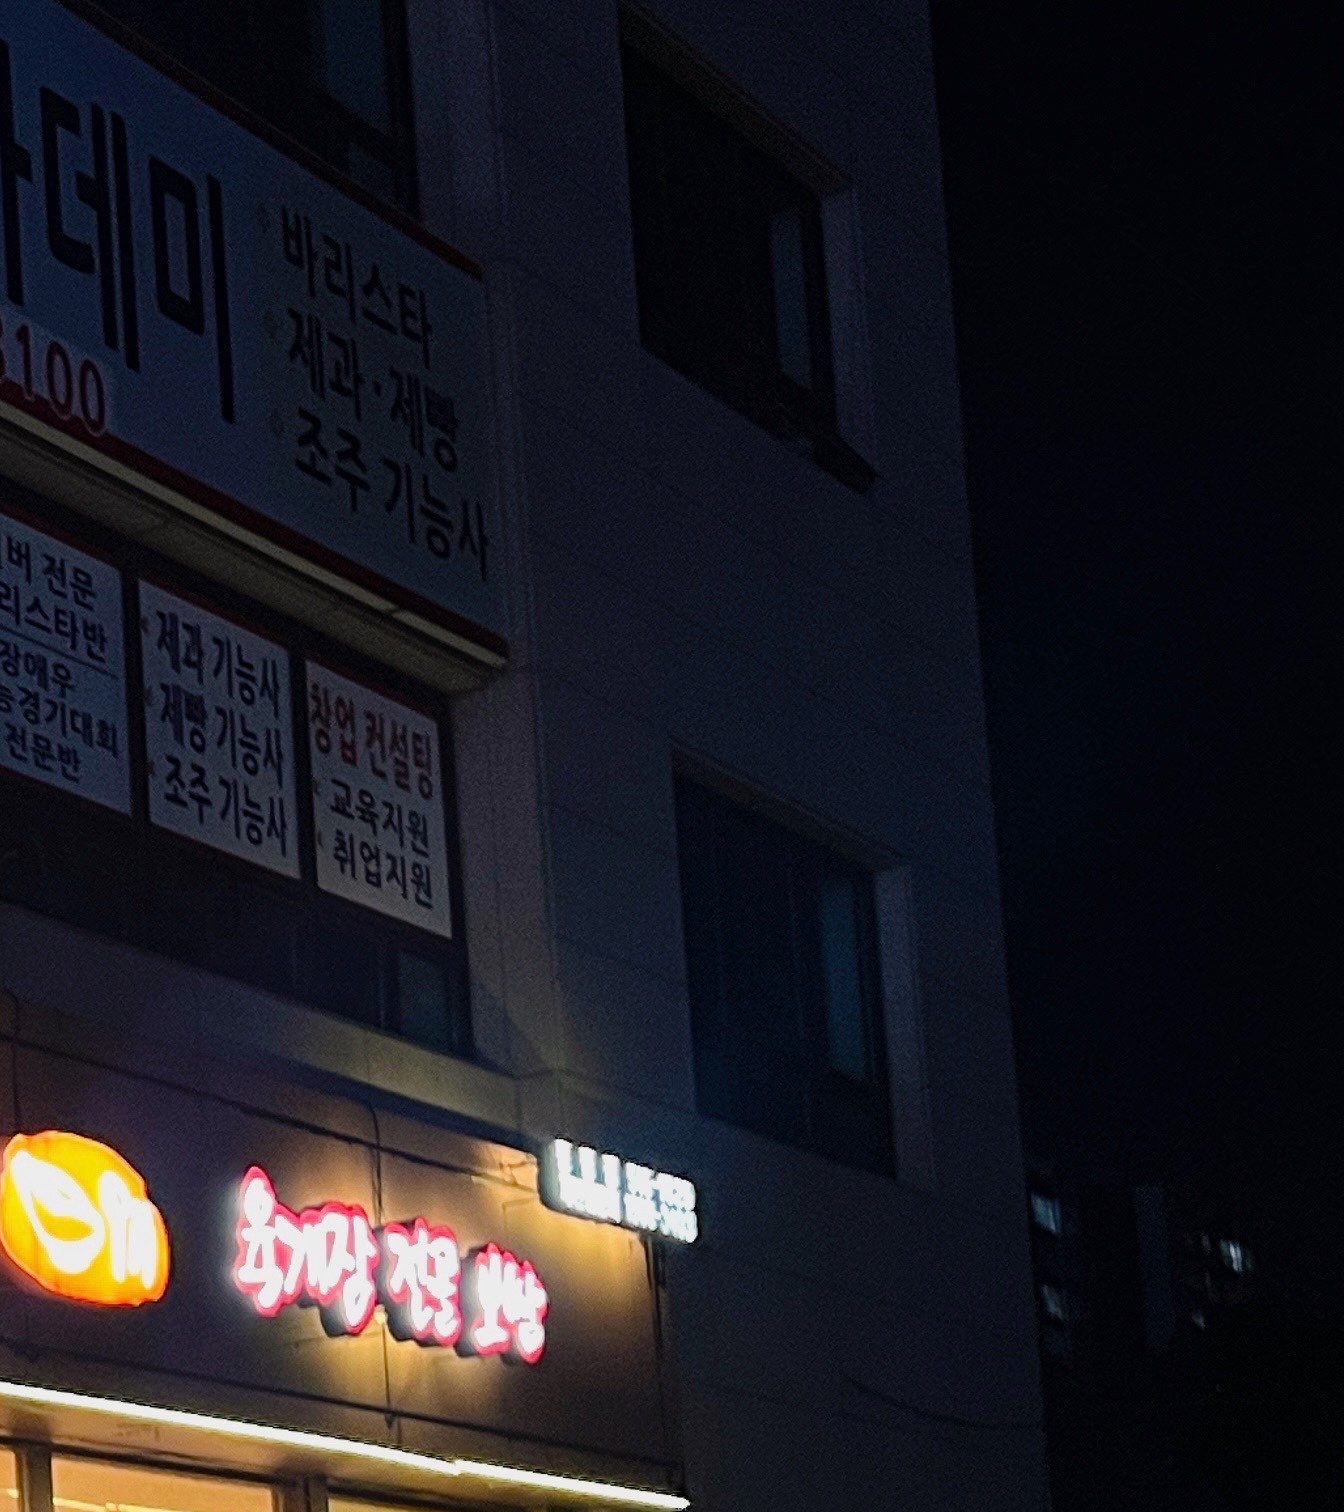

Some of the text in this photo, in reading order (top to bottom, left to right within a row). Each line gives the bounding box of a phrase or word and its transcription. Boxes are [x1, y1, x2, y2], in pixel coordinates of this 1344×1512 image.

[281, 206, 433, 370] 바리스타
[295, 405, 489, 581] 조주 기능사
[41, 553, 96, 612] 전문
[156, 610, 281, 719] 제과 기능사
[5, 721, 83, 783] 전문반
[215, 706, 284, 790] 기능사
[310, 682, 358, 767] 창업
[165, 755, 289, 858] 조주 기능사
